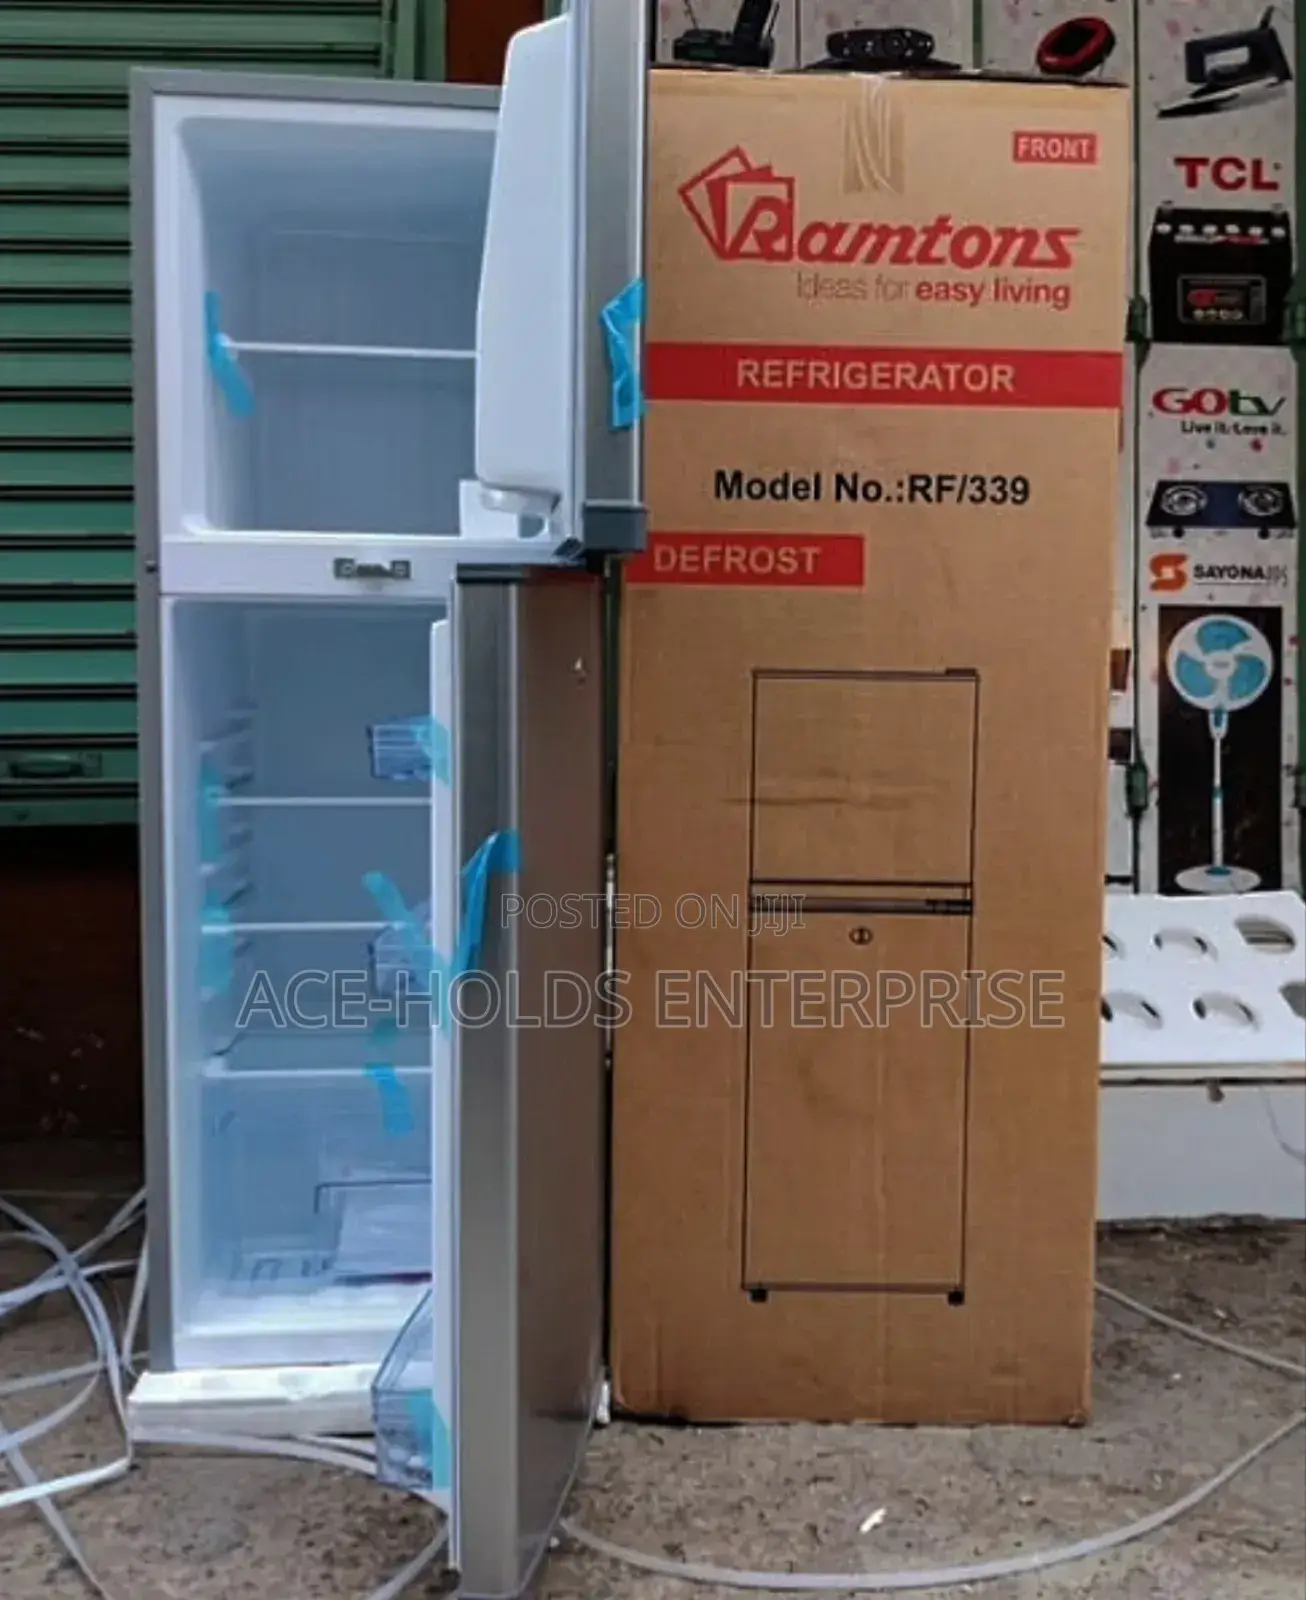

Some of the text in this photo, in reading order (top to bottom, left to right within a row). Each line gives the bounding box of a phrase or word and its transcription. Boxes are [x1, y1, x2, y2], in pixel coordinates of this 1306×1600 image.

[1017, 137, 1093, 159] FRONT
[1174, 157, 1279, 191] TCL
[726, 196, 1081, 269] Ramtons
[797, 272, 1070, 310] Ideas for easy living
[737, 359, 1015, 393] REFRIGERATOR
[714, 470, 1030, 505] Model No.:RF/339
[653, 545, 821, 575] DEFROST
